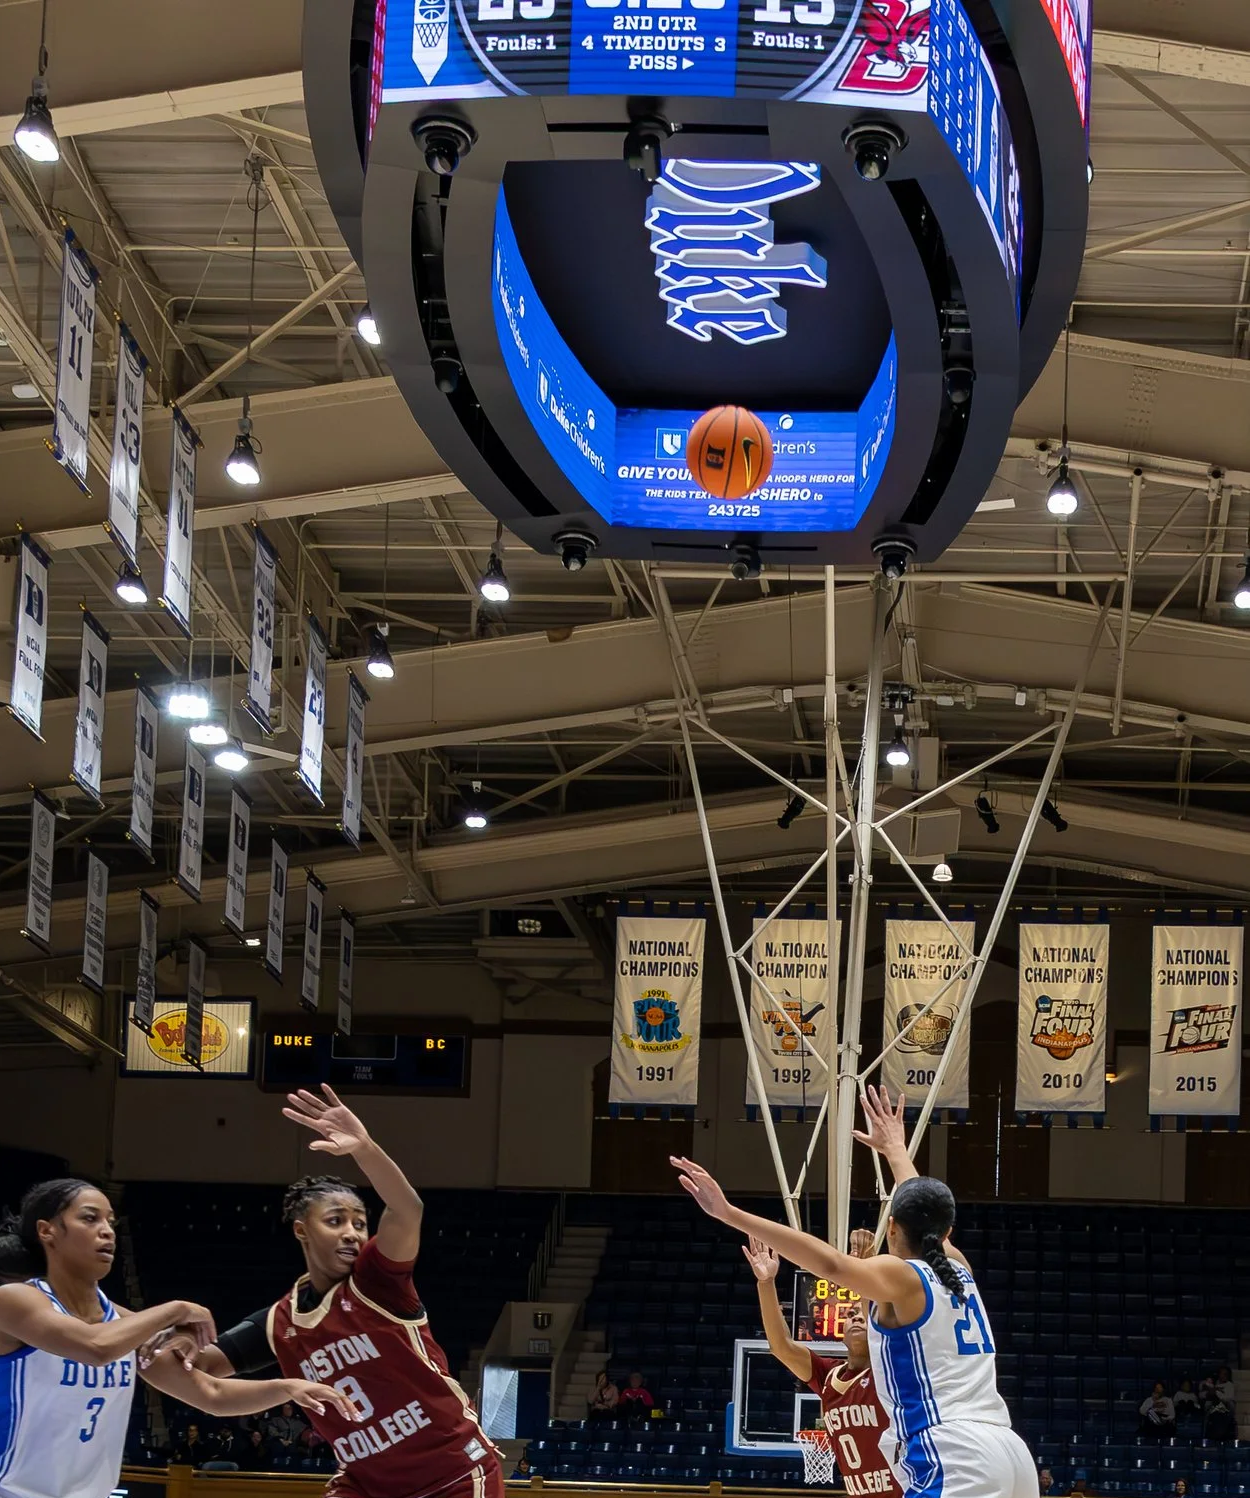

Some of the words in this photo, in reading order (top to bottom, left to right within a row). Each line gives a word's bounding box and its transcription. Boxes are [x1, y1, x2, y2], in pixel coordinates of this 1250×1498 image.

[613, 15, 652, 30] 2ND
[658, 16, 697, 33] QTR
[486, 35, 541, 52] Fouls:
[546, 35, 556, 50] 1
[582, 35, 593, 50] 4
[603, 36, 704, 51] TIMEOUTS
[714, 37, 726, 52] 3
[753, 31, 809, 50] Fouls:
[814, 35, 825, 50] 1
[629, 55, 677, 70] POSS
[550, 394, 569, 434] Duke
[570, 422, 606, 475] Children's
[772, 440, 816, 454] dren's
[618, 466, 654, 480] GIVE
[657, 467, 691, 481] YOU
[775, 475, 807, 483] HOOPS
[809, 475, 834, 483] HERO
[835, 475, 855, 483] FOR
[645, 489, 663, 498] THE
[664, 489, 687, 499] KIDS
[708, 504, 761, 517] 243725
[629, 940, 692, 957] NATIONAL
[765, 942, 828, 958] NATIONAL
[898, 943, 962, 960] NATIONAL
[1032, 947, 1096, 963] NATIONAL
[1166, 949, 1230, 965] NATIONAL
[620, 960, 699, 978] CHAMPIONS
[756, 961, 828, 978] CHAMPION
[890, 964, 968, 981] CHAMPIONS
[1025, 967, 1104, 984] CHAMPIONS
[1158, 970, 1238, 986] CHAMPIONS
[647, 990, 666, 998] 1991
[633, 998, 679, 1014] FINAL
[1050, 1001, 1094, 1018] FINAL
[1033, 1012, 1094, 1036] FOUR
[1188, 1009, 1231, 1026] FINAL
[274, 1035, 313, 1047] DUKE
[426, 1039, 445, 1050] BC
[1037, 1035, 1088, 1047] INDIANAPOLIS
[636, 1065, 675, 1081] 1991
[772, 1068, 811, 1084] 1992
[906, 1070, 944, 1086] 200
[1042, 1073, 1083, 1089] 2010
[1176, 1077, 1216, 1092] 2015
[950, 1293, 996, 1355] 21
[60, 1359, 131, 1388] DUKE
[79, 1397, 105, 1442] 3
[333, 1400, 432, 1463] COLLEGE
[838, 1433, 861, 1470] 0
[843, 1468, 893, 1496] OLLEGE
